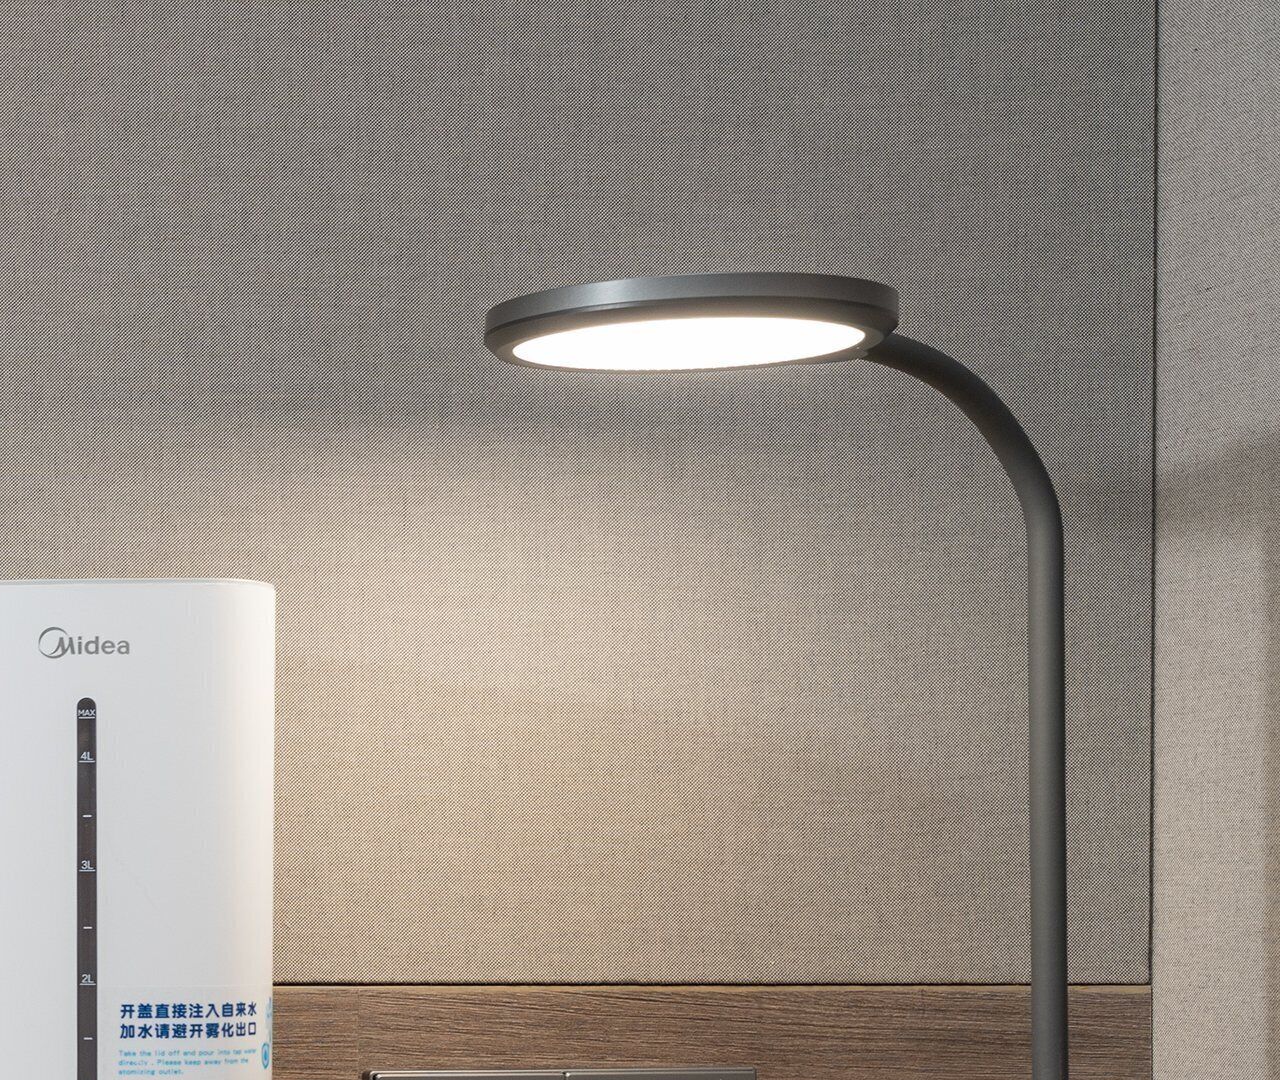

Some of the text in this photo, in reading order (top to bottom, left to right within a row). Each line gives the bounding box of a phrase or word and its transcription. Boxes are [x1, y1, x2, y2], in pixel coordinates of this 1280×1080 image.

[38, 626, 130, 658] Midea
[77, 709, 96, 717] MAX
[80, 751, 94, 761] 4L
[81, 860, 94, 870] 3L
[81, 974, 95, 984] 2L
[120, 1002, 257, 1019] 开盖直接注入自来水
[120, 1022, 257, 1039] 加水请避开雾化出口
